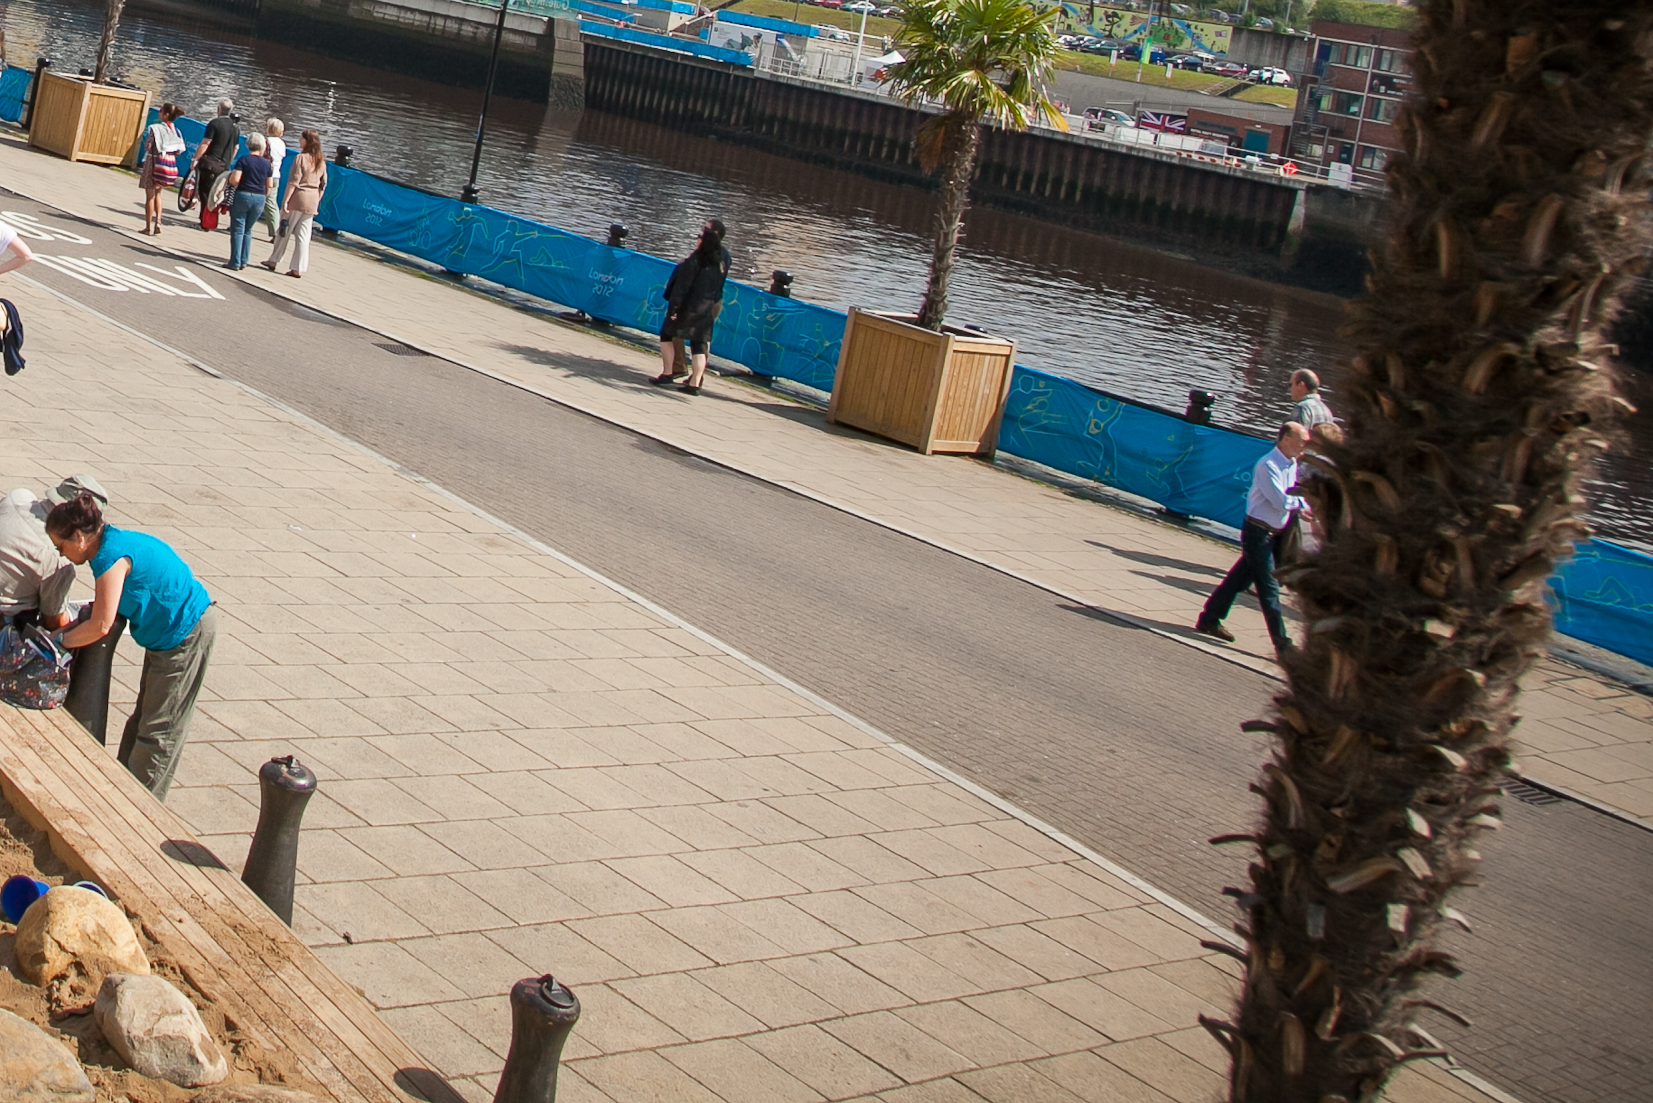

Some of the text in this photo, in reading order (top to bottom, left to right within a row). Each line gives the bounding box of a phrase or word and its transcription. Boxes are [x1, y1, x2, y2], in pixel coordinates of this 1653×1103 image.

[362, 198, 392, 217] London
[365, 212, 383, 227] 2012
[30, 253, 227, 300] ONLY
[589, 266, 624, 286] London
[592, 282, 614, 298] 2012
